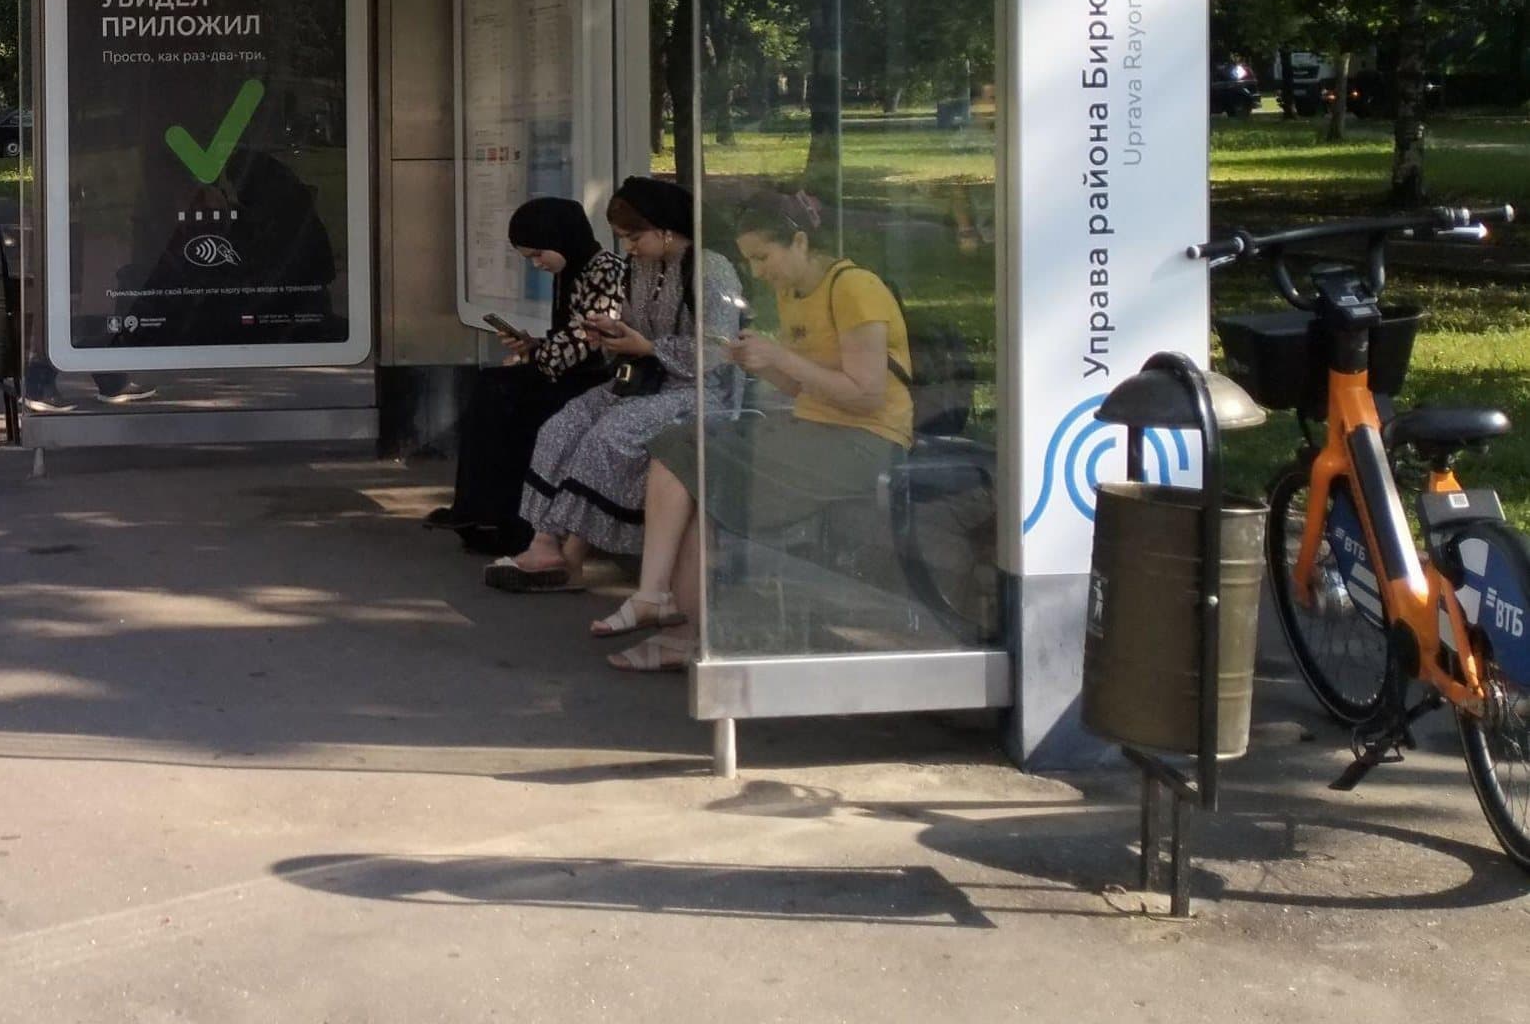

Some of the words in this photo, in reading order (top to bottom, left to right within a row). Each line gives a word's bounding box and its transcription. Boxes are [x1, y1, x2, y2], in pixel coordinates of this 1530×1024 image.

[102, 15, 260, 38] ПРИЛОЖИЛ
[102, 50, 155, 65] Просто,
[158, 51, 180, 62] как
[183, 49, 266, 64] раз-два-три.
[1123, 79, 1146, 166] Uprava
[1083, 102, 1114, 235] района
[1083, 248, 1114, 378] Управа
[1343, 536, 1366, 561] ВТБ
[1495, 598, 1523, 637] ВТБ
